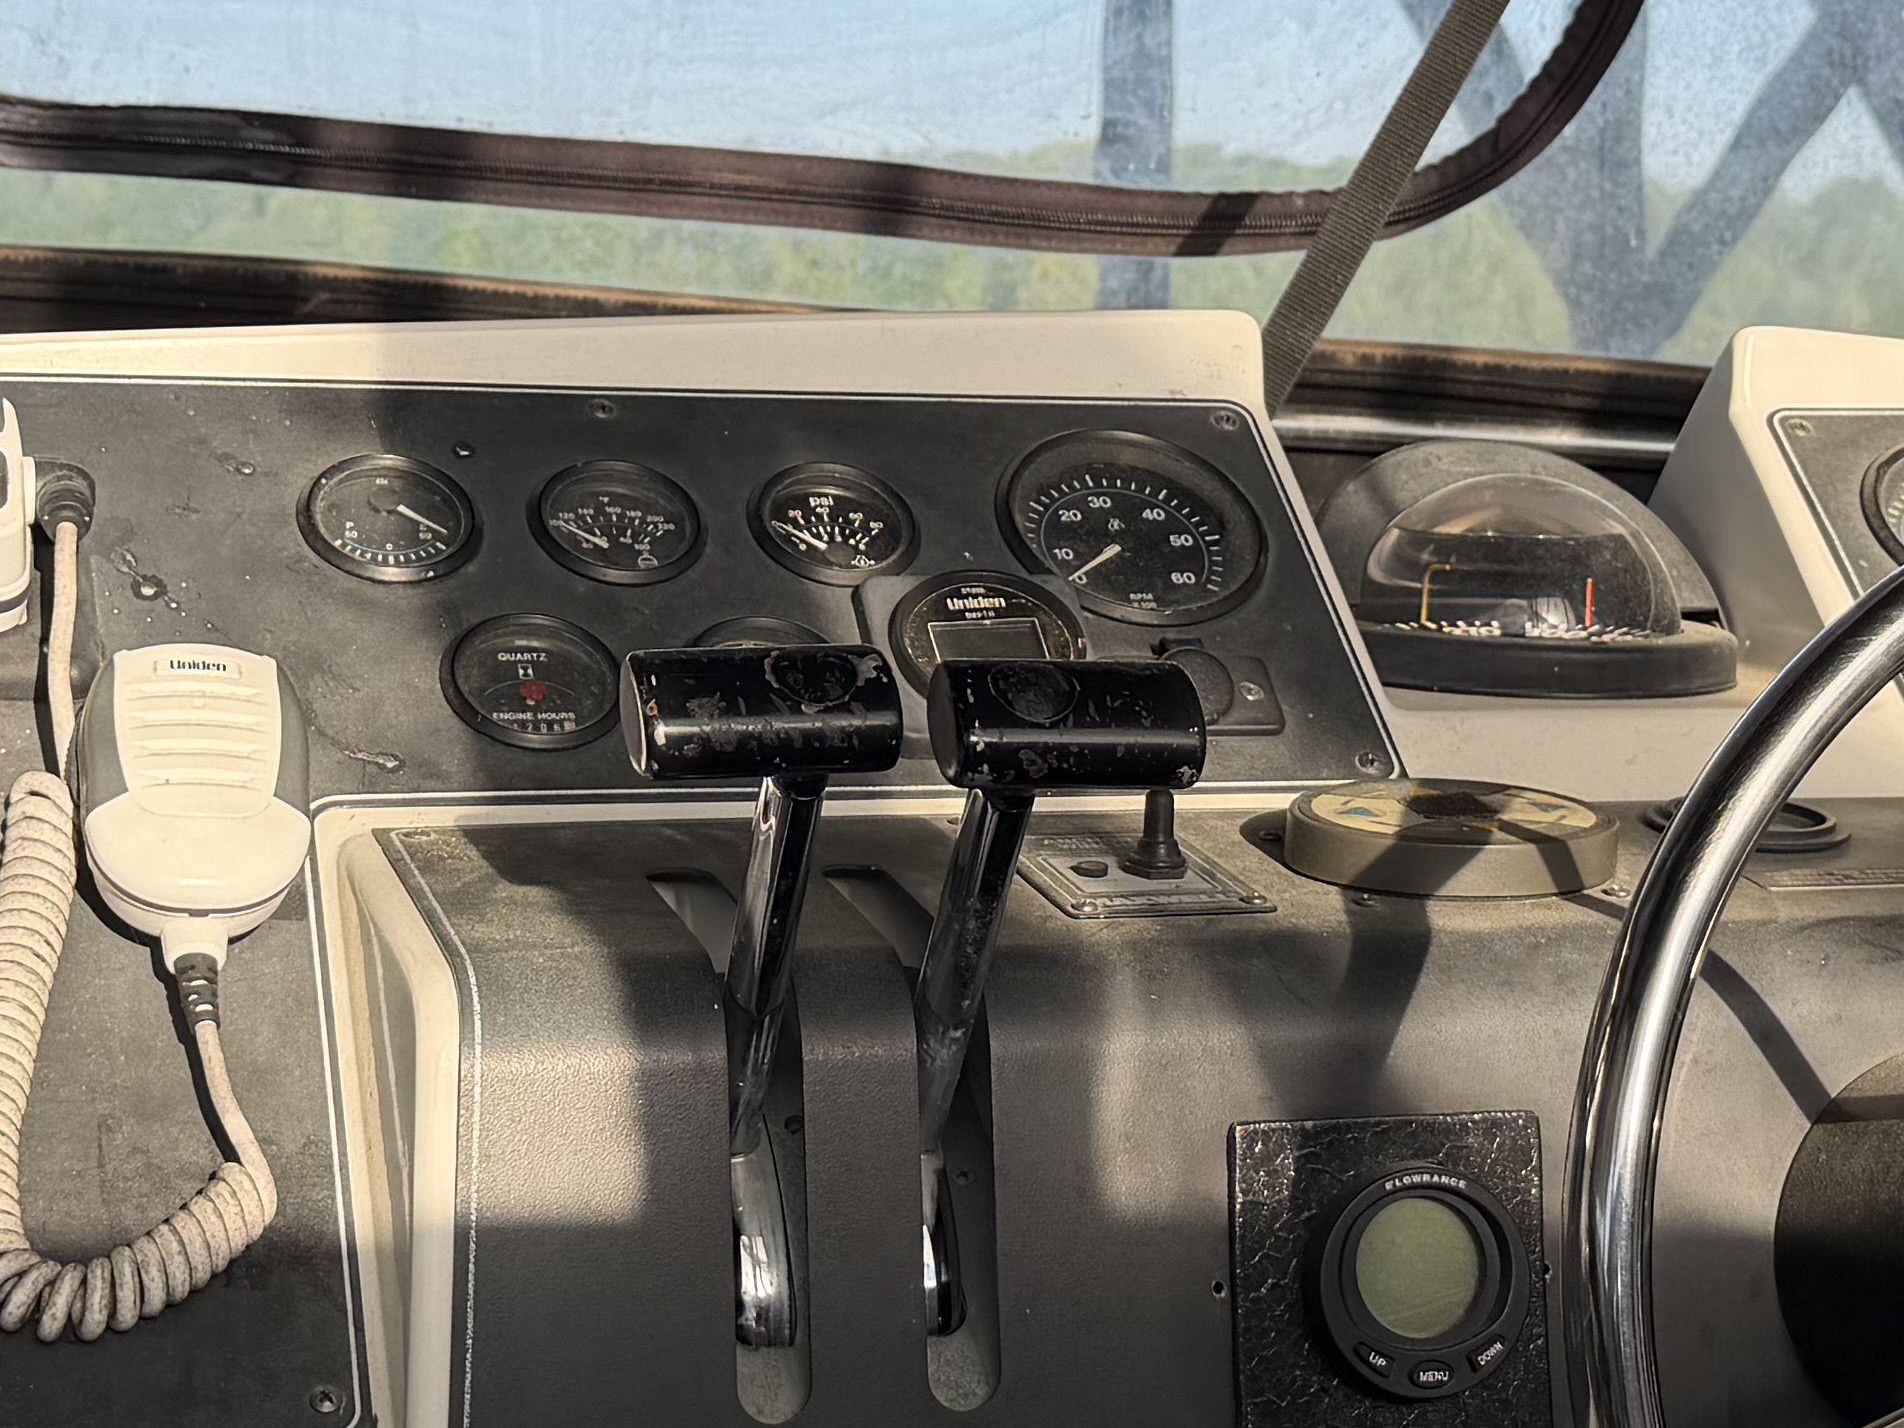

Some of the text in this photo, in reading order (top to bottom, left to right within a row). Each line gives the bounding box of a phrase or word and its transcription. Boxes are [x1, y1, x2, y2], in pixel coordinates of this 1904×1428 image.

[1087, 495, 1113, 510] 30
[1058, 509, 1083, 523] 20
[1141, 507, 1166, 522] 40
[1168, 533, 1194, 548] 50
[1052, 547, 1075, 561] 10
[1170, 571, 1196, 585] 60
[946, 595, 1007, 612] Uniden
[497, 652, 547, 662] QUARTZ
[169, 659, 227, 672] Uniden
[492, 711, 576, 721] ENGINE HOURS
[1395, 1173, 1467, 1189] LOWRANCE
[1368, 1351, 1387, 1368] UP
[1476, 1340, 1505, 1367] DOWN
[1418, 1370, 1450, 1383] MENU
